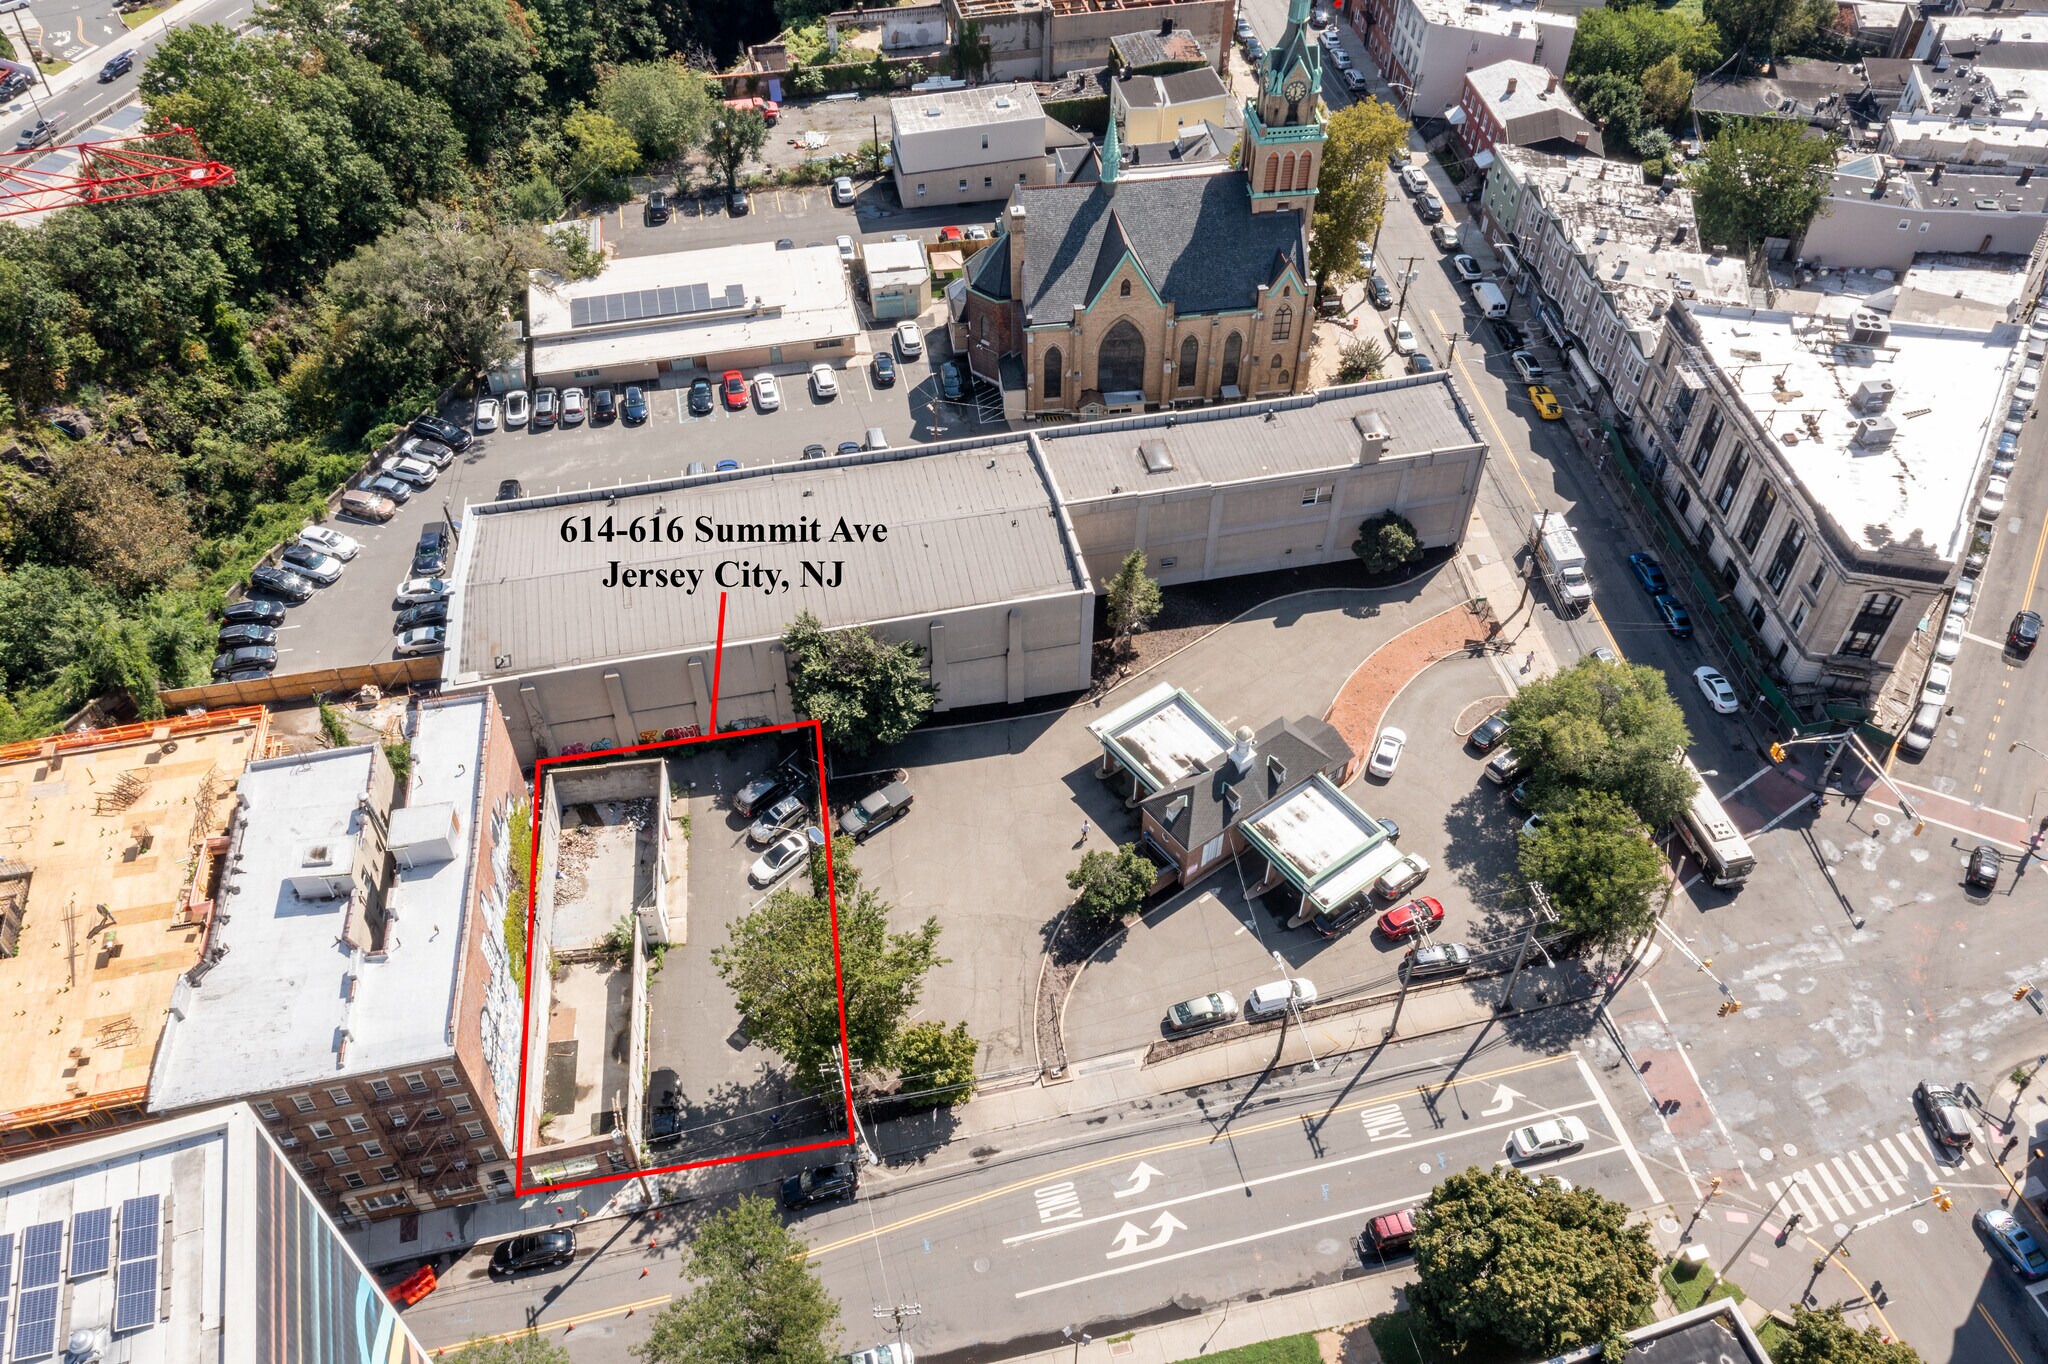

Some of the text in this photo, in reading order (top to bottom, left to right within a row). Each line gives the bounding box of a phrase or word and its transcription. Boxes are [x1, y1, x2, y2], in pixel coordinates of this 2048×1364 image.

[48, 30, 71, 39] ONLY
[63, 45, 83, 58] STOP
[1361, 1104, 1412, 1142] ONLY
[1034, 1181, 1084, 1224] ONLY
